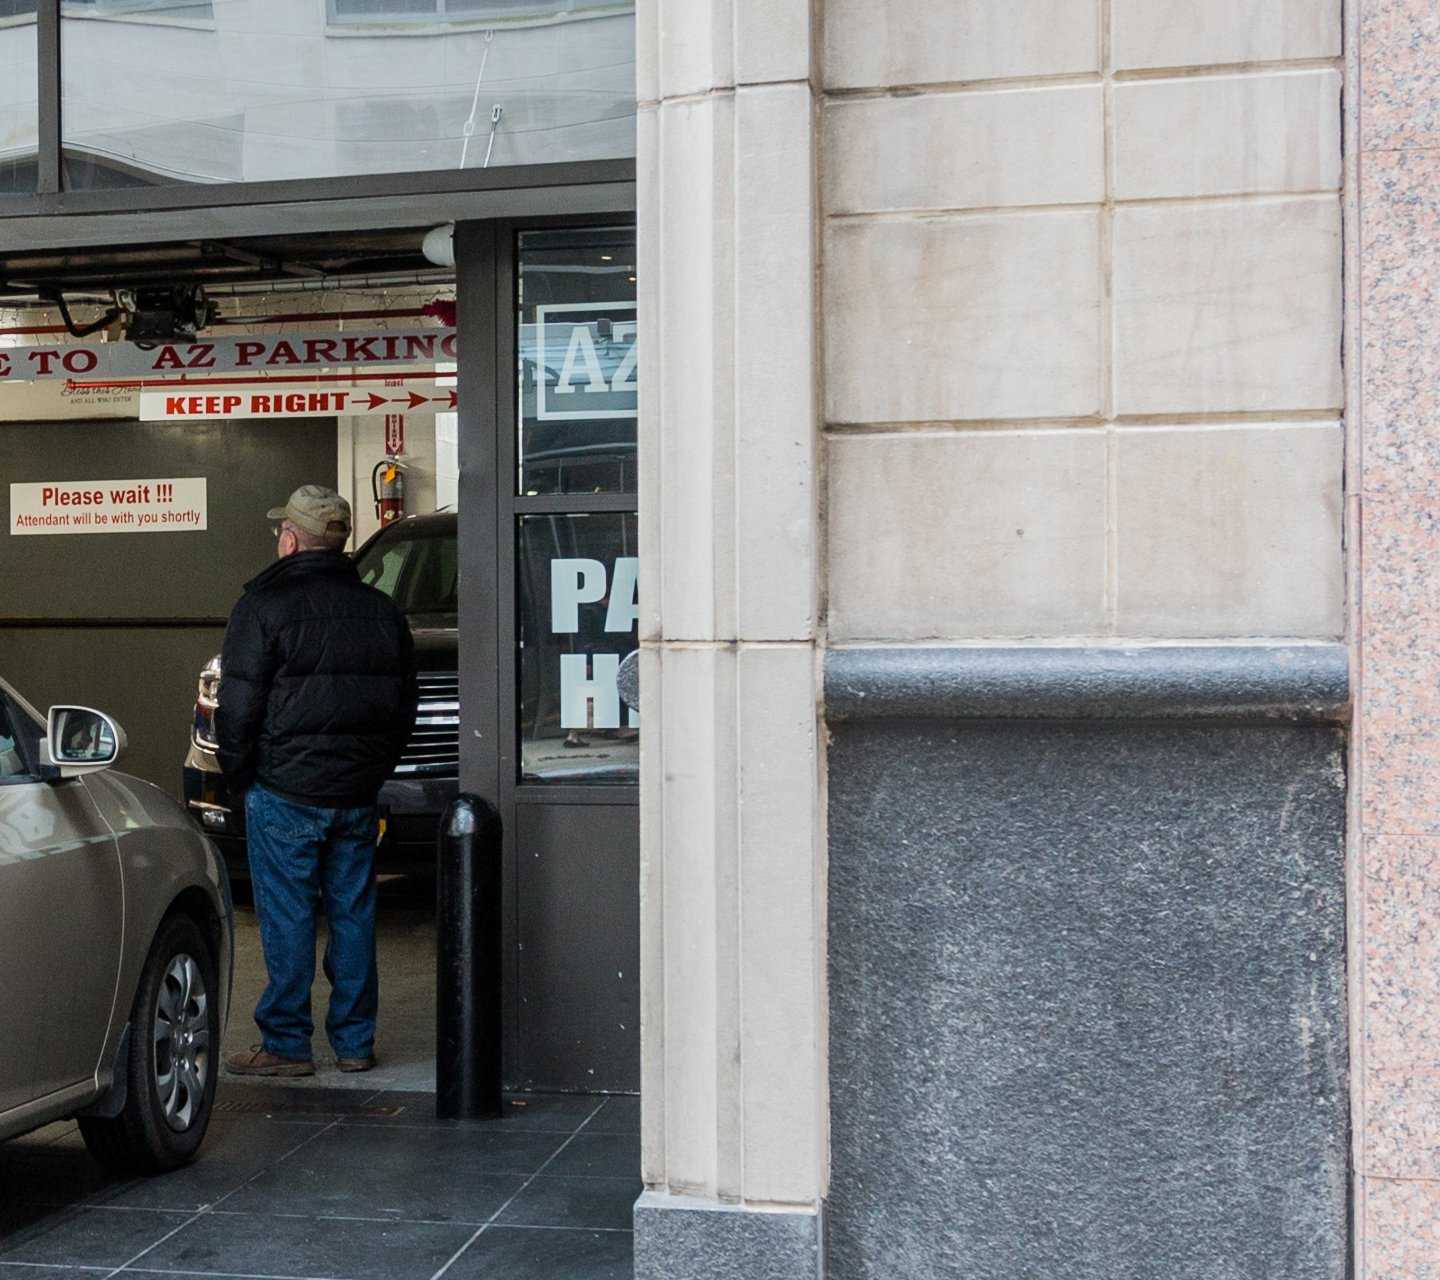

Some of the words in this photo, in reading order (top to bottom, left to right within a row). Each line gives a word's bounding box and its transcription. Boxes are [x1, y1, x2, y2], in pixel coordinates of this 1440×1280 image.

[28, 349, 100, 377] TO
[151, 341, 218, 370] AZ
[166, 396, 241, 415] KEEP
[251, 392, 349, 413] RIGHT
[42, 487, 104, 506] Please
[110, 485, 150, 504] wait
[157, 484, 173, 503] !!!
[15, 512, 69, 527] Attendant
[73, 513, 92, 525] will
[94, 512, 108, 525] be
[111, 512, 135, 524] with
[138, 513, 159, 527] you
[162, 510, 201, 527] shortly
